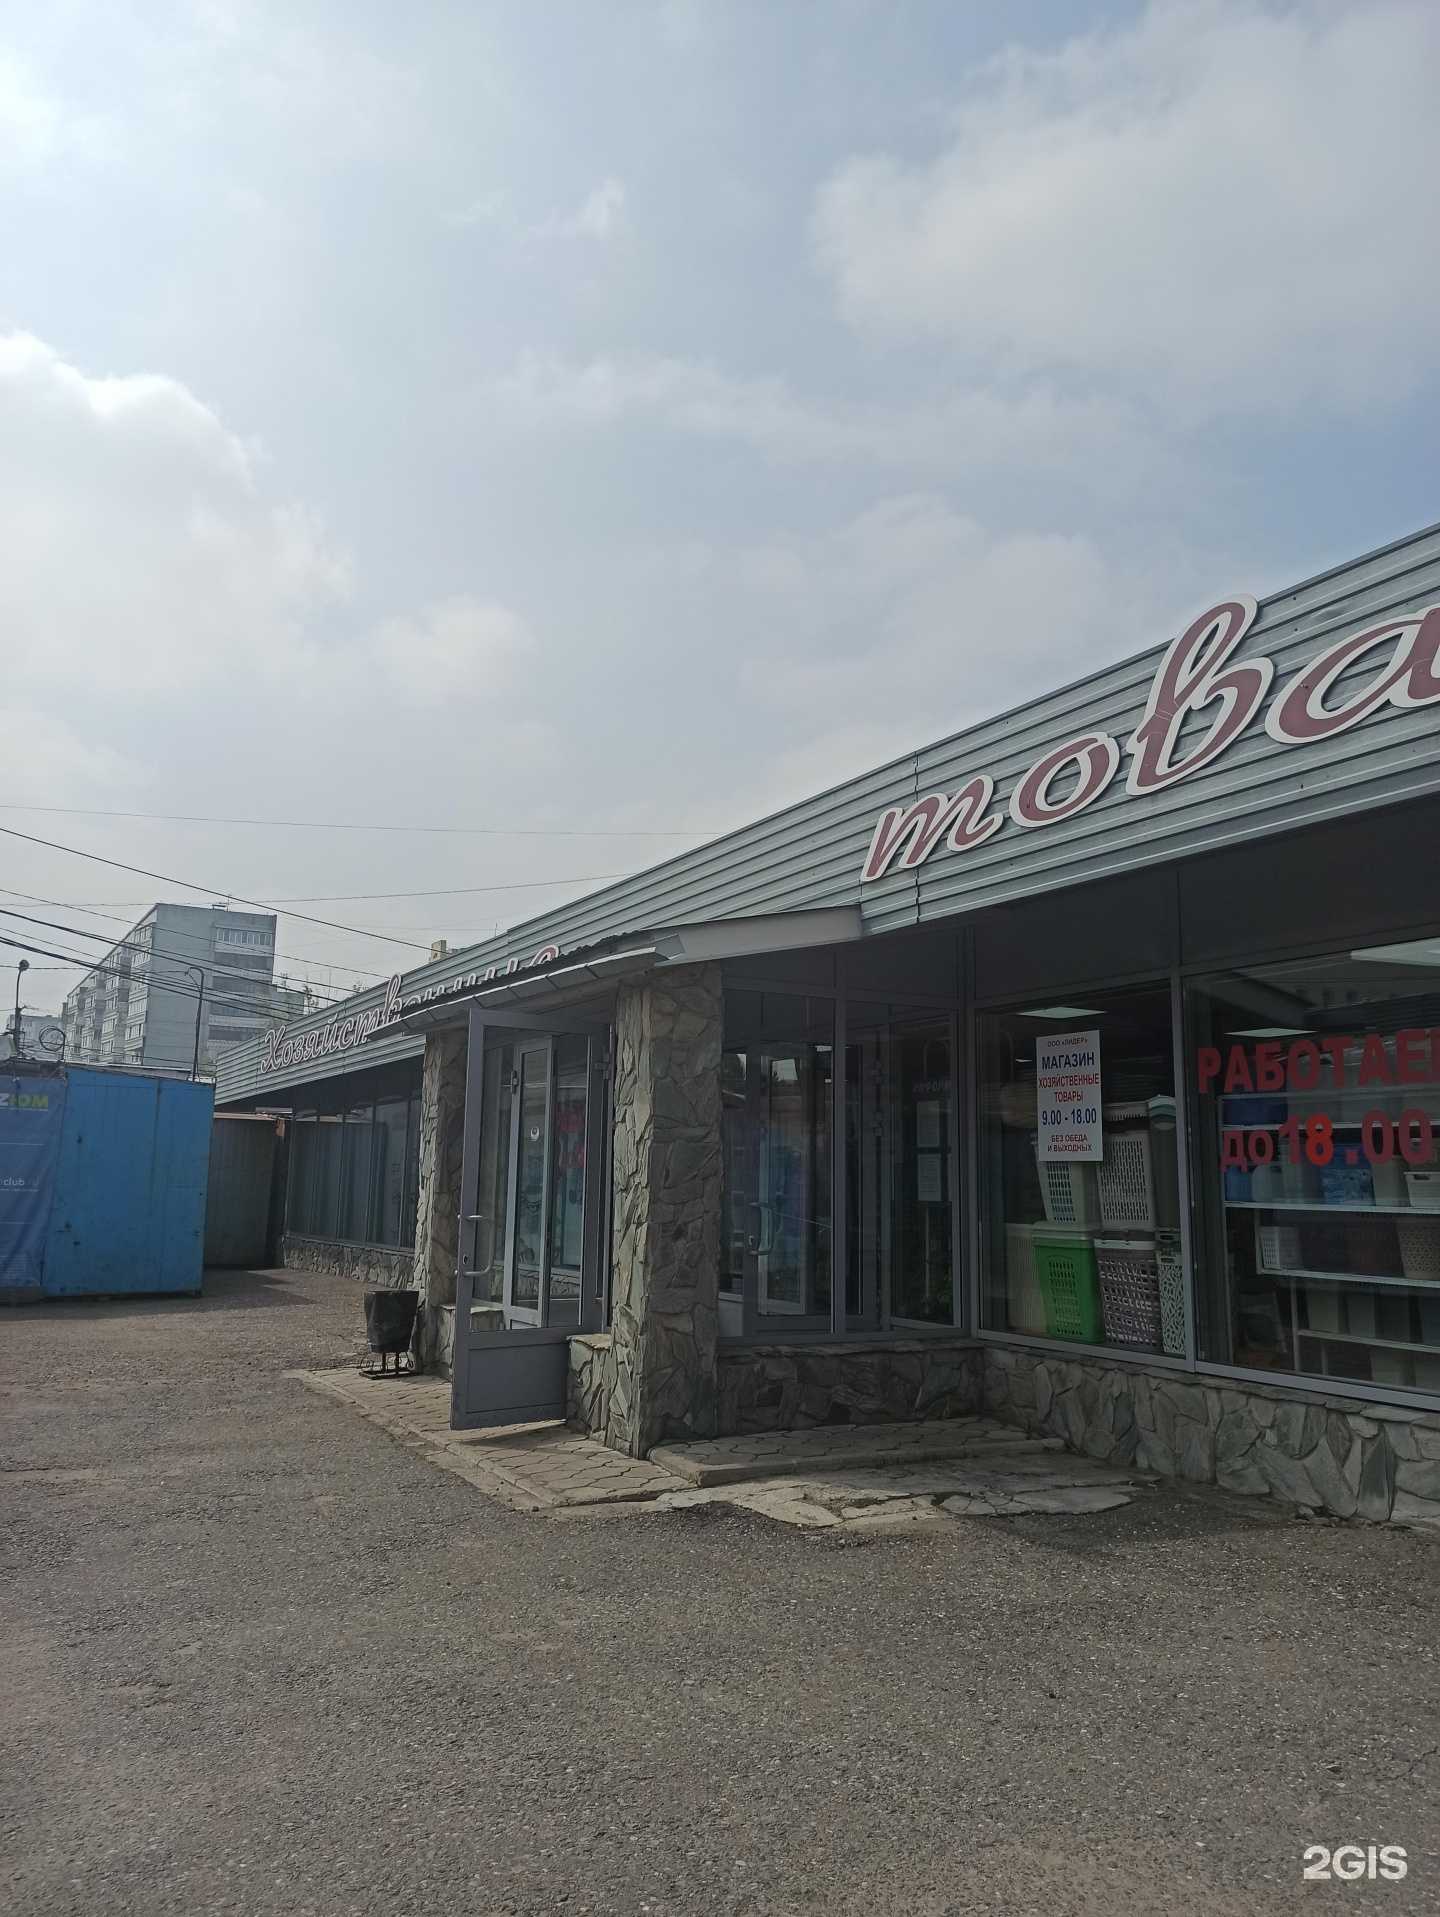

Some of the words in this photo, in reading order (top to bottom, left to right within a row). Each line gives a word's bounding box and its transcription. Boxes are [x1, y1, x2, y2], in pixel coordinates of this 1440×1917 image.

[1047, 1039, 1061, 1048] ООО
[1042, 1052, 1095, 1070] МАГАЗИН
[1039, 1072, 1100, 1089] ХОЗЯЙСТВЕННЫЕ
[1054, 1090, 1084, 1103] ТОВАРЫ
[1042, 1109, 1062, 1126] 9.00
[1071, 1107, 1097, 1125] 18.00
[1051, 1134, 1064, 1143] БЕЗ
[1065, 1133, 1088, 1143] ОБЕДА
[1053, 1143, 1093, 1153] ВЫХОДНЫХ
[1220, 1130, 1274, 1173] до
